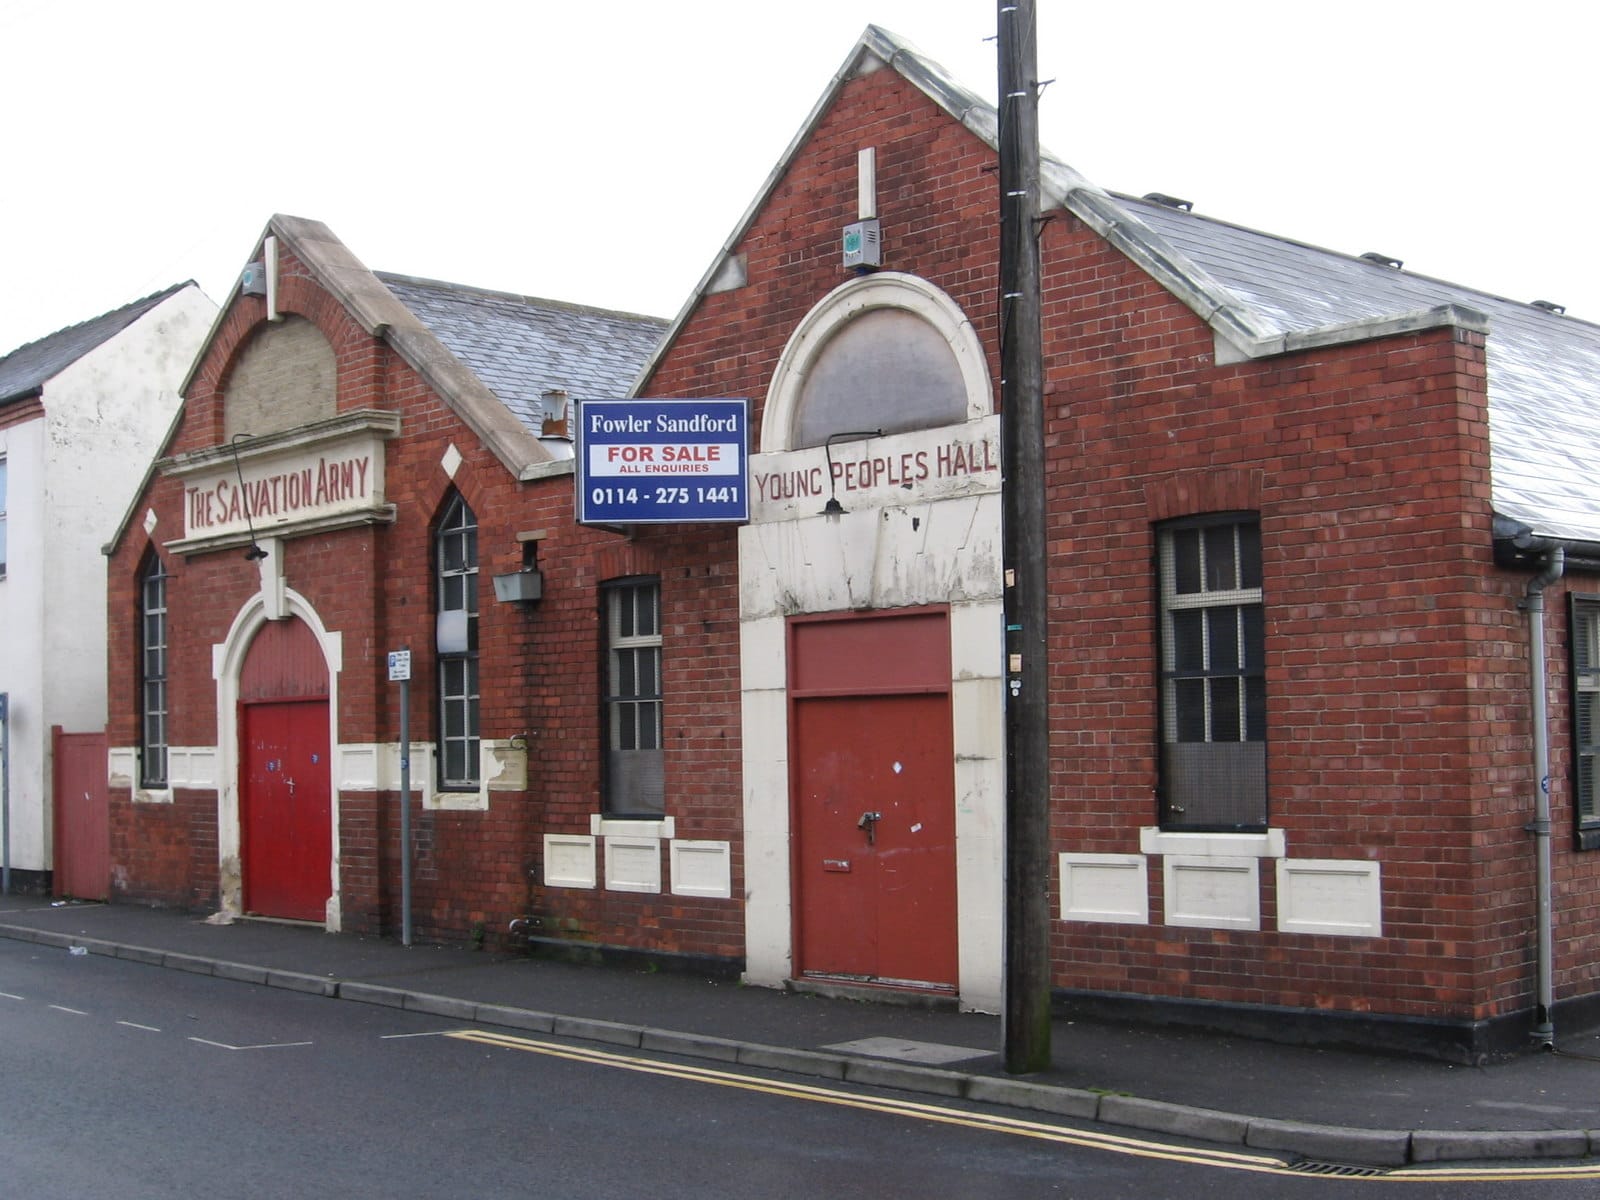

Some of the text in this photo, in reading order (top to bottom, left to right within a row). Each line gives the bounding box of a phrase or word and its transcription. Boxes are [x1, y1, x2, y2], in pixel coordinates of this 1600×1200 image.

[590, 413, 737, 433] Fowler Sandford
[607, 446, 721, 462] FOR SALE
[619, 463, 709, 473] ALL ENQUIRIES
[831, 451, 929, 492] PEOPLES
[936, 440, 998, 478] HALL
[186, 456, 369, 529] THE SALVATION ARMY
[592, 488, 639, 505] 0114
[655, 487, 689, 504] 275
[697, 486, 738, 503] 1441
